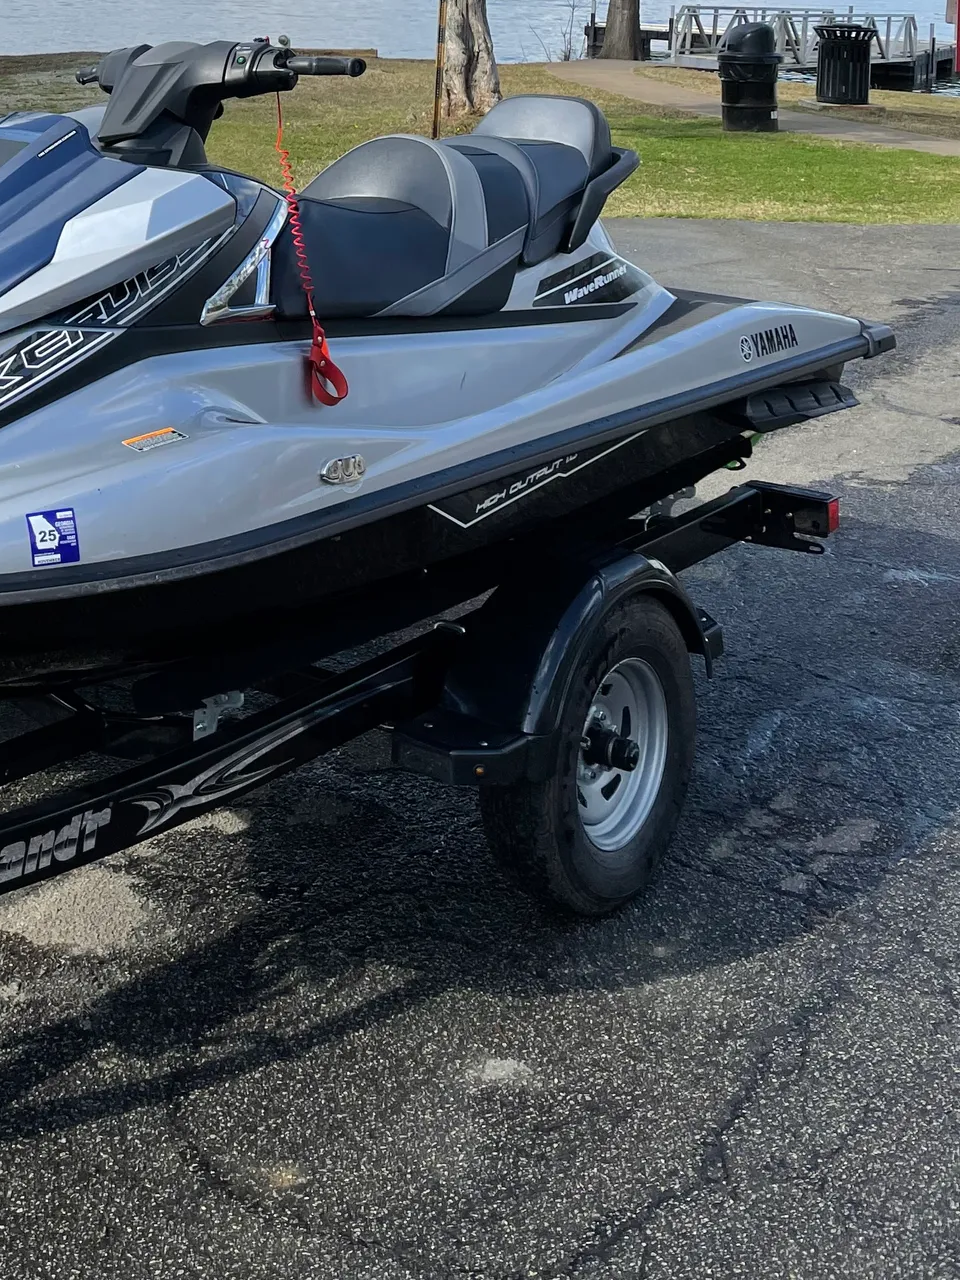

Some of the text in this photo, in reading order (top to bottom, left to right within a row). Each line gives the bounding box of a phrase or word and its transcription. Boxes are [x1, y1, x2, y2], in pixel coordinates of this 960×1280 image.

[564, 264, 627, 304] WaveRunner
[750, 323, 799, 358] YAMAHA
[509, 458, 563, 494] OUTPUT
[38, 529, 57, 543] 25
